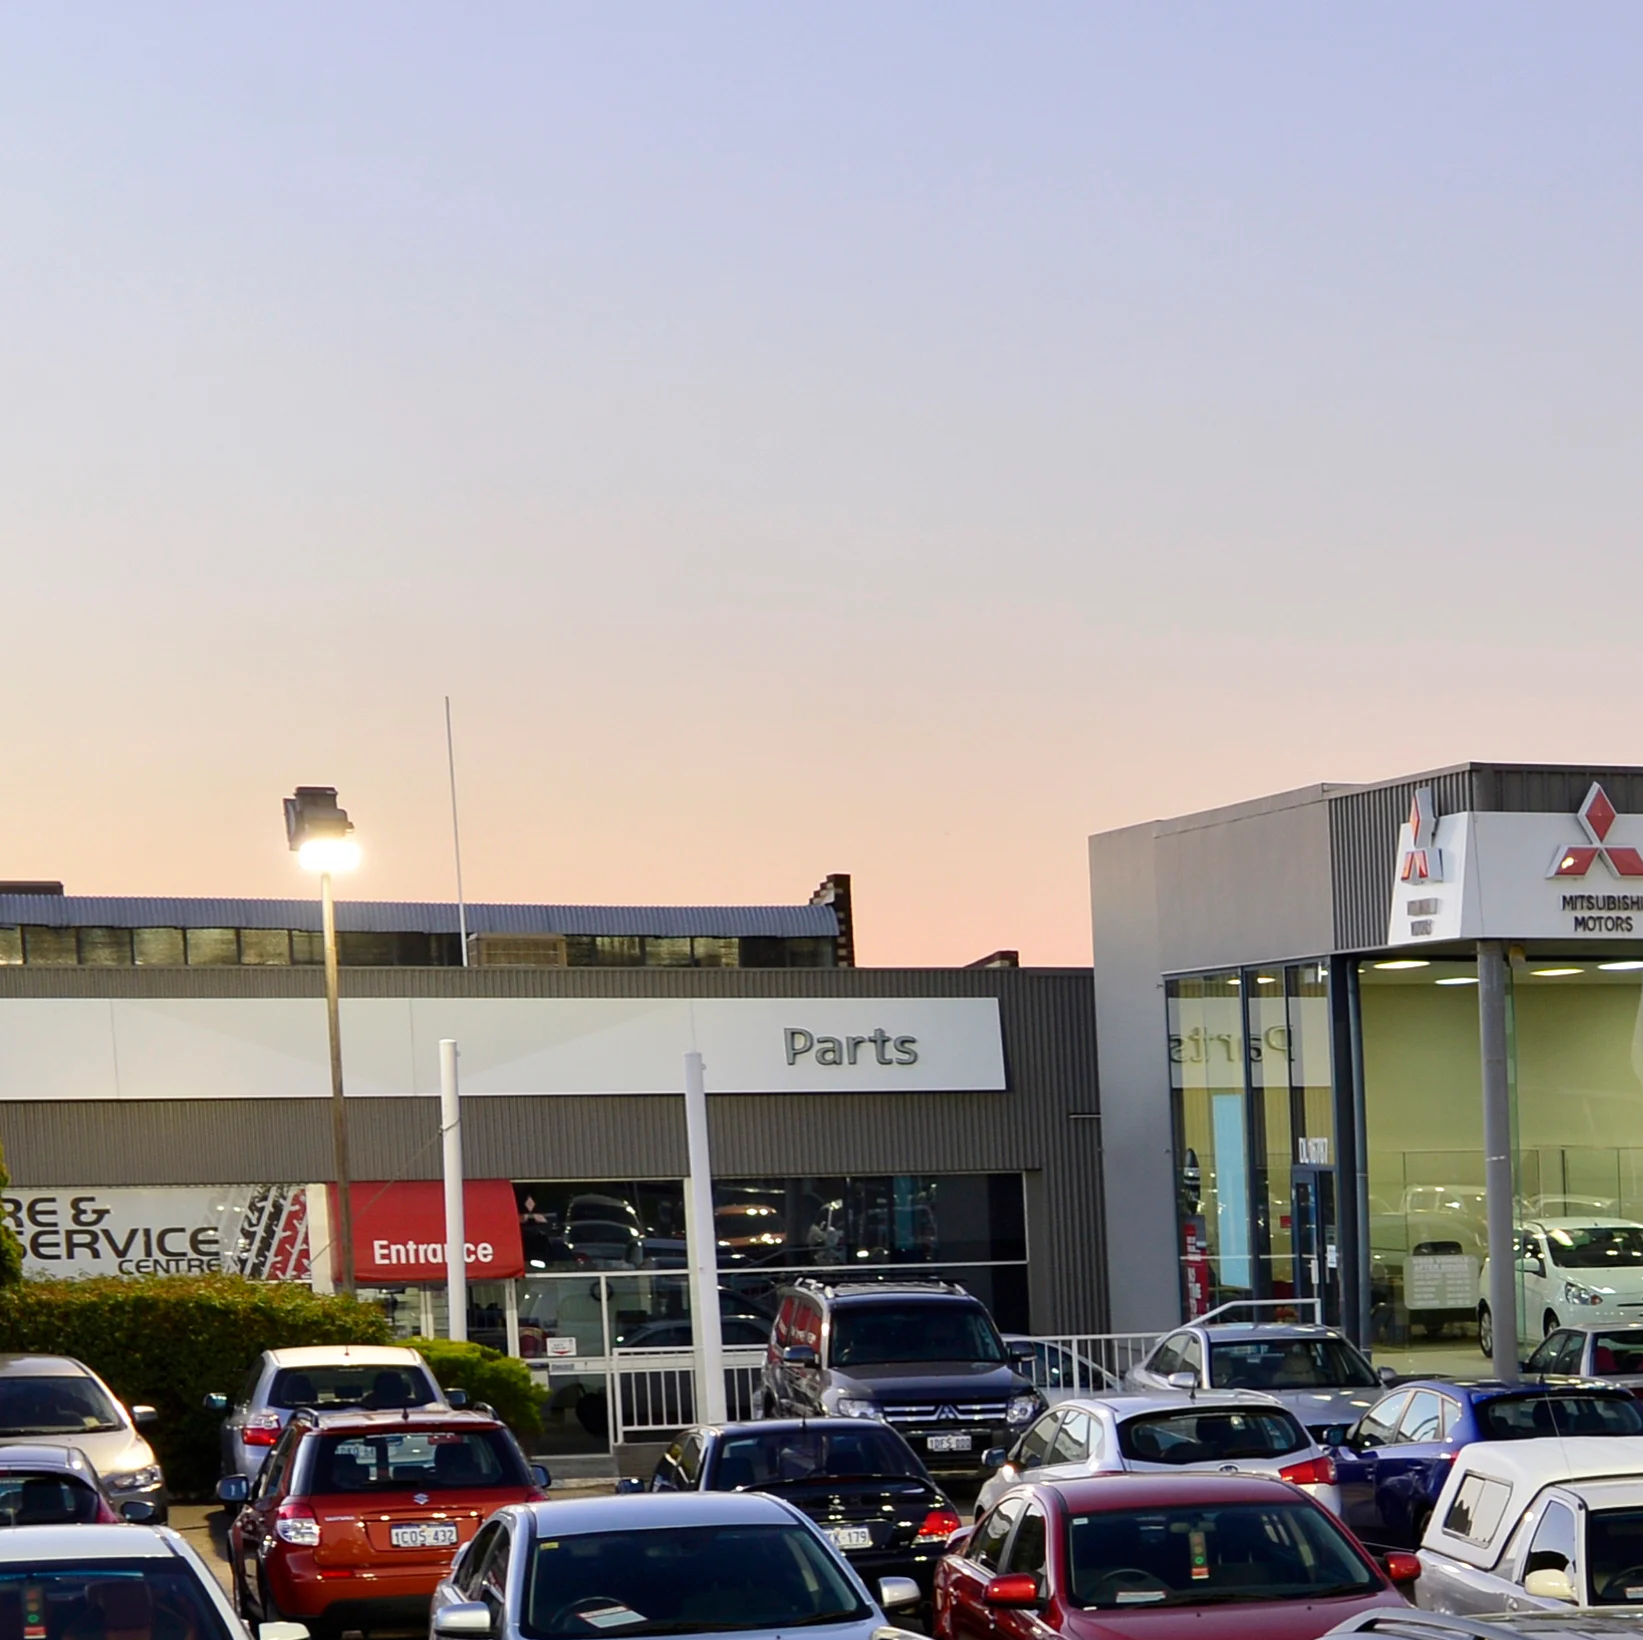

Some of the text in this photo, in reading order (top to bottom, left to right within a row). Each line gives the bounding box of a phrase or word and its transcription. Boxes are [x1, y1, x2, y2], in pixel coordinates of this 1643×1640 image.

[1562, 895, 1643, 911] MITSUBISHI
[1574, 916, 1633, 932] MOTORS
[783, 1027, 918, 1066] Parts
[70, 1196, 111, 1227] &
[373, 1240, 494, 1265] Entrace
[117, 1257, 222, 1276] CENTRE
